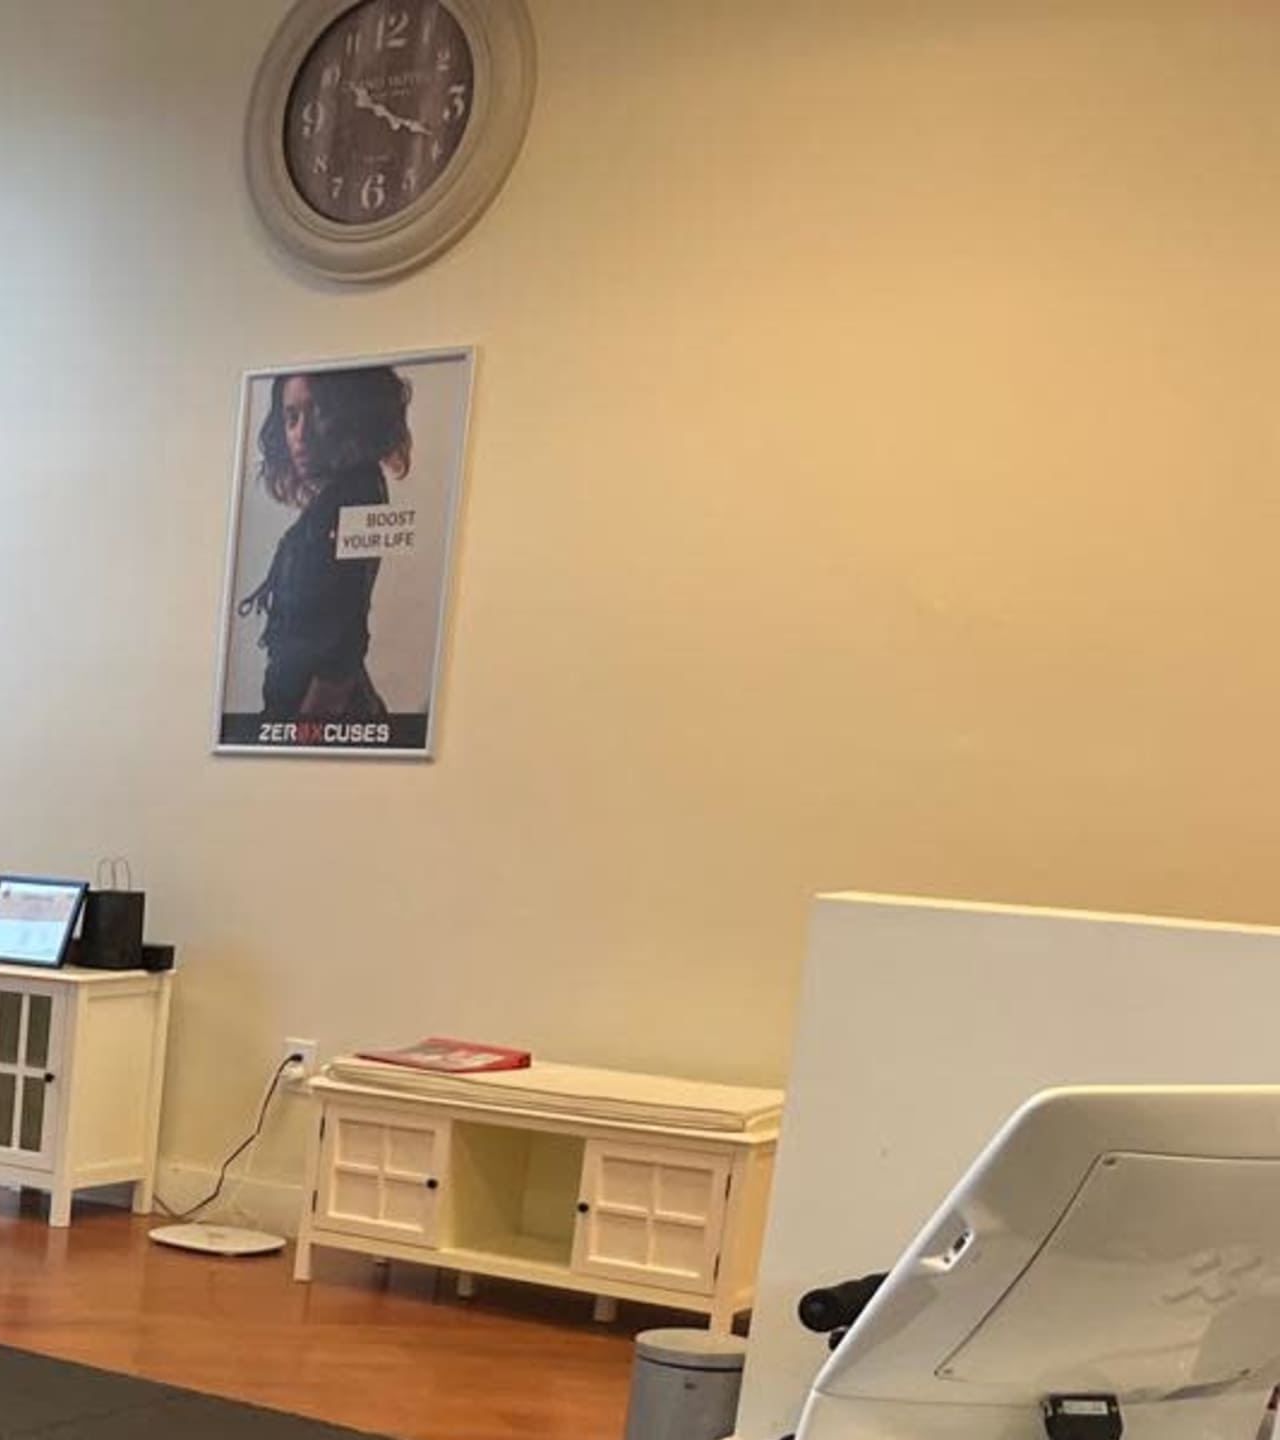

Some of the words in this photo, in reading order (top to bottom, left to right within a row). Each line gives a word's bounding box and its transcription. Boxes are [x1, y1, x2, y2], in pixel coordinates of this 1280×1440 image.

[376, 12, 409, 50] 12
[346, 32, 361, 55] 11
[436, 50, 451, 71] 2
[442, 84, 466, 121] 3
[302, 101, 324, 138] 9
[312, 153, 328, 174] 8
[331, 176, 344, 200] 7
[360, 174, 386, 211] 6
[366, 510, 417, 529] BOOST
[343, 533, 381, 550] YOUR
[383, 531, 415, 548] LIFE
